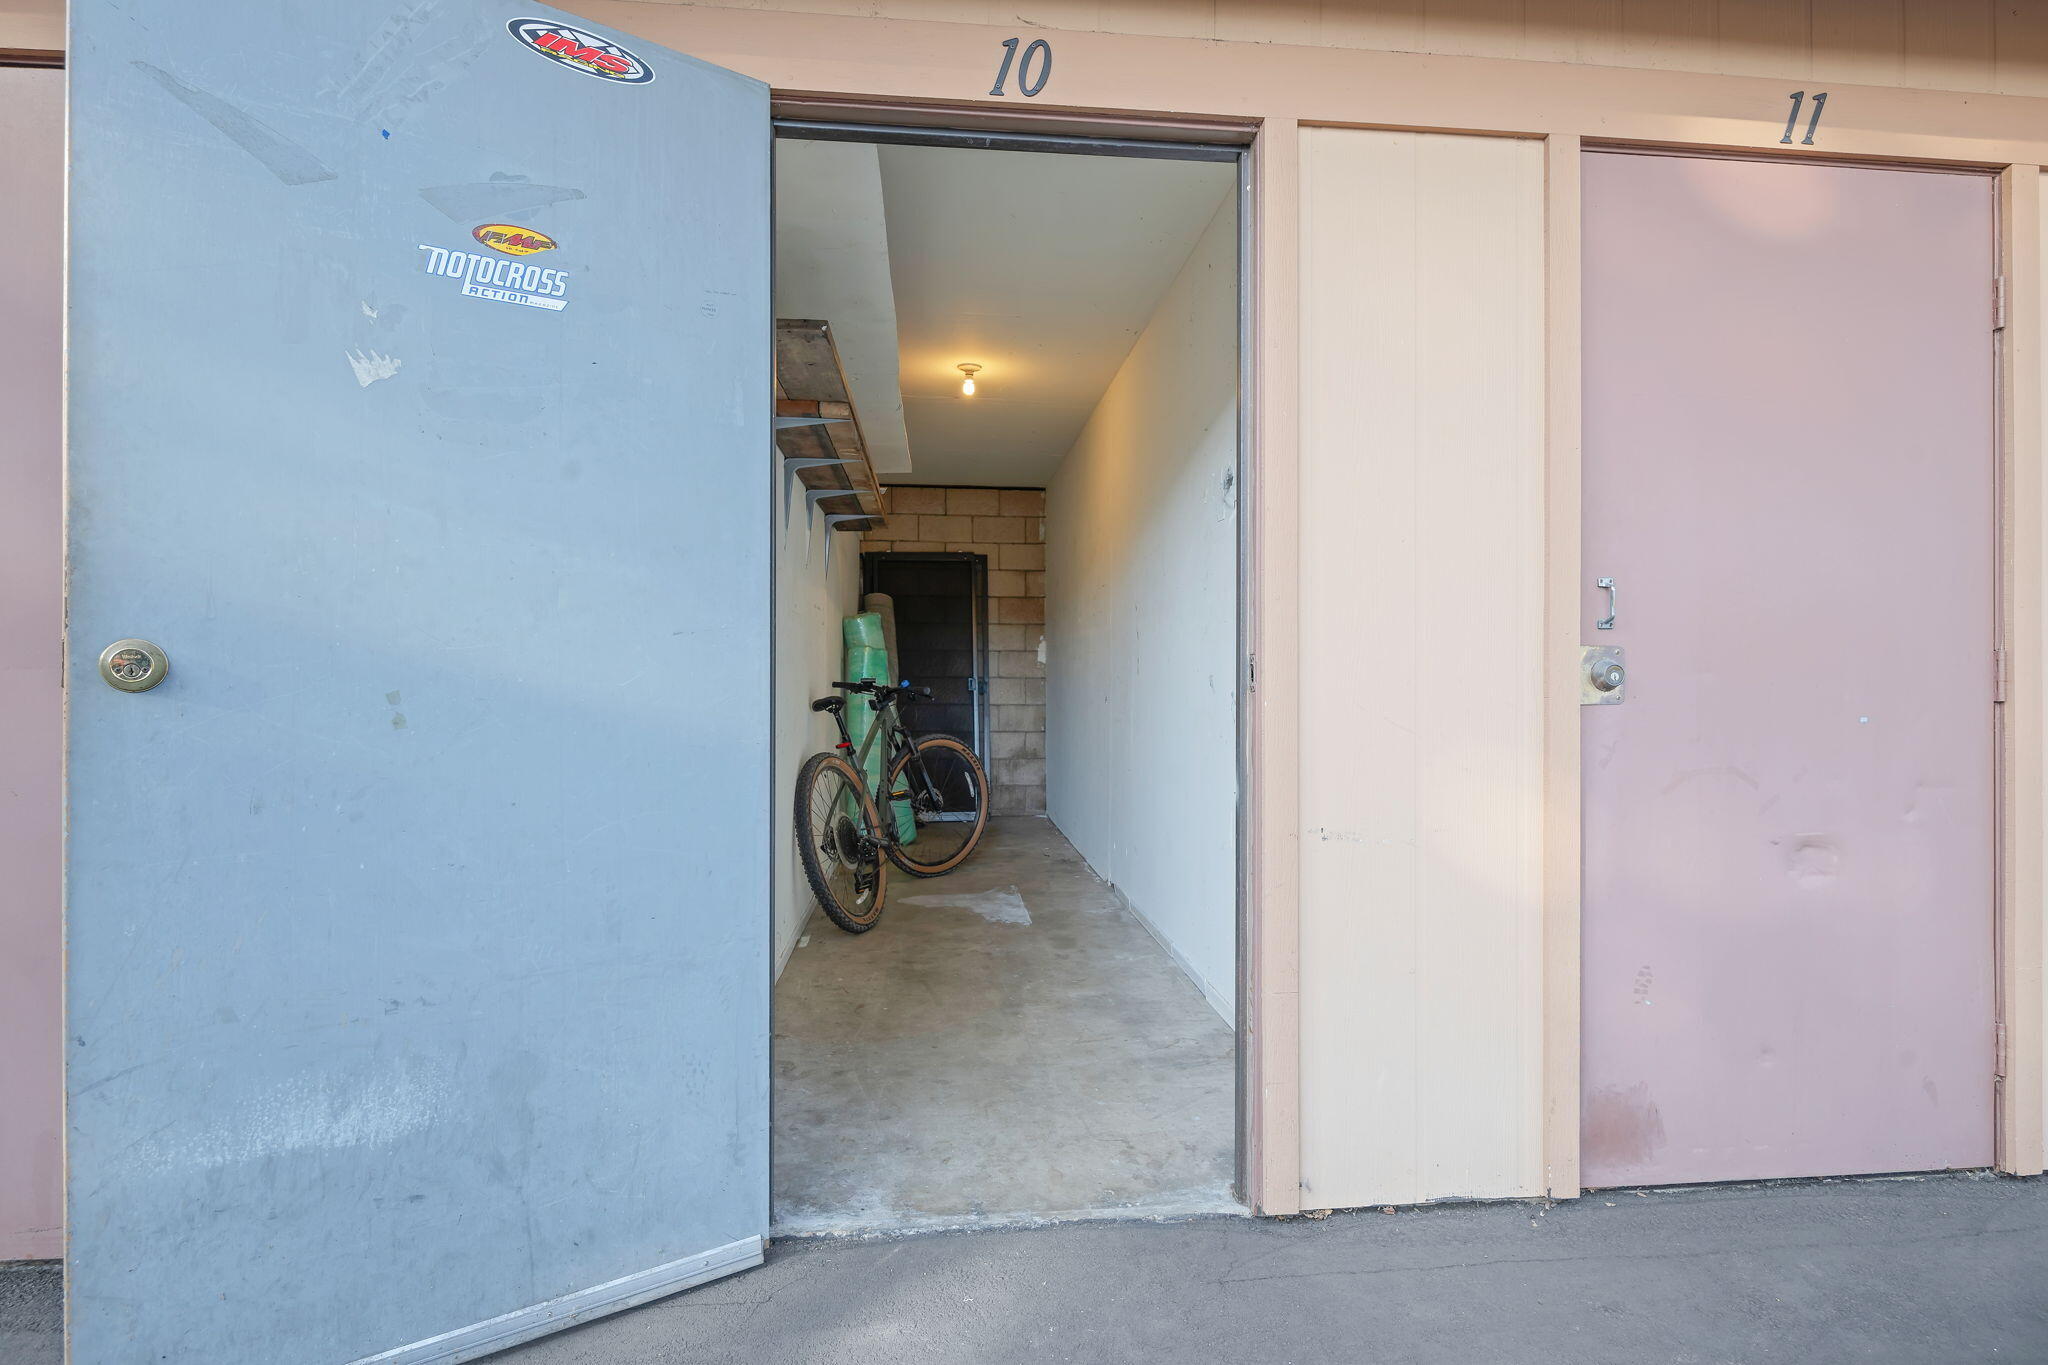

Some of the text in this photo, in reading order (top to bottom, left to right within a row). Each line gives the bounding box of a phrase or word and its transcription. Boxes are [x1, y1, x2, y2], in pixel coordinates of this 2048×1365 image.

[533, 32, 633, 73] IMS
[989, 37, 1052, 97] 10
[1780, 91, 1828, 145] 11
[418, 244, 569, 297] MOTOCROSS
[468, 286, 528, 304] ACTION
